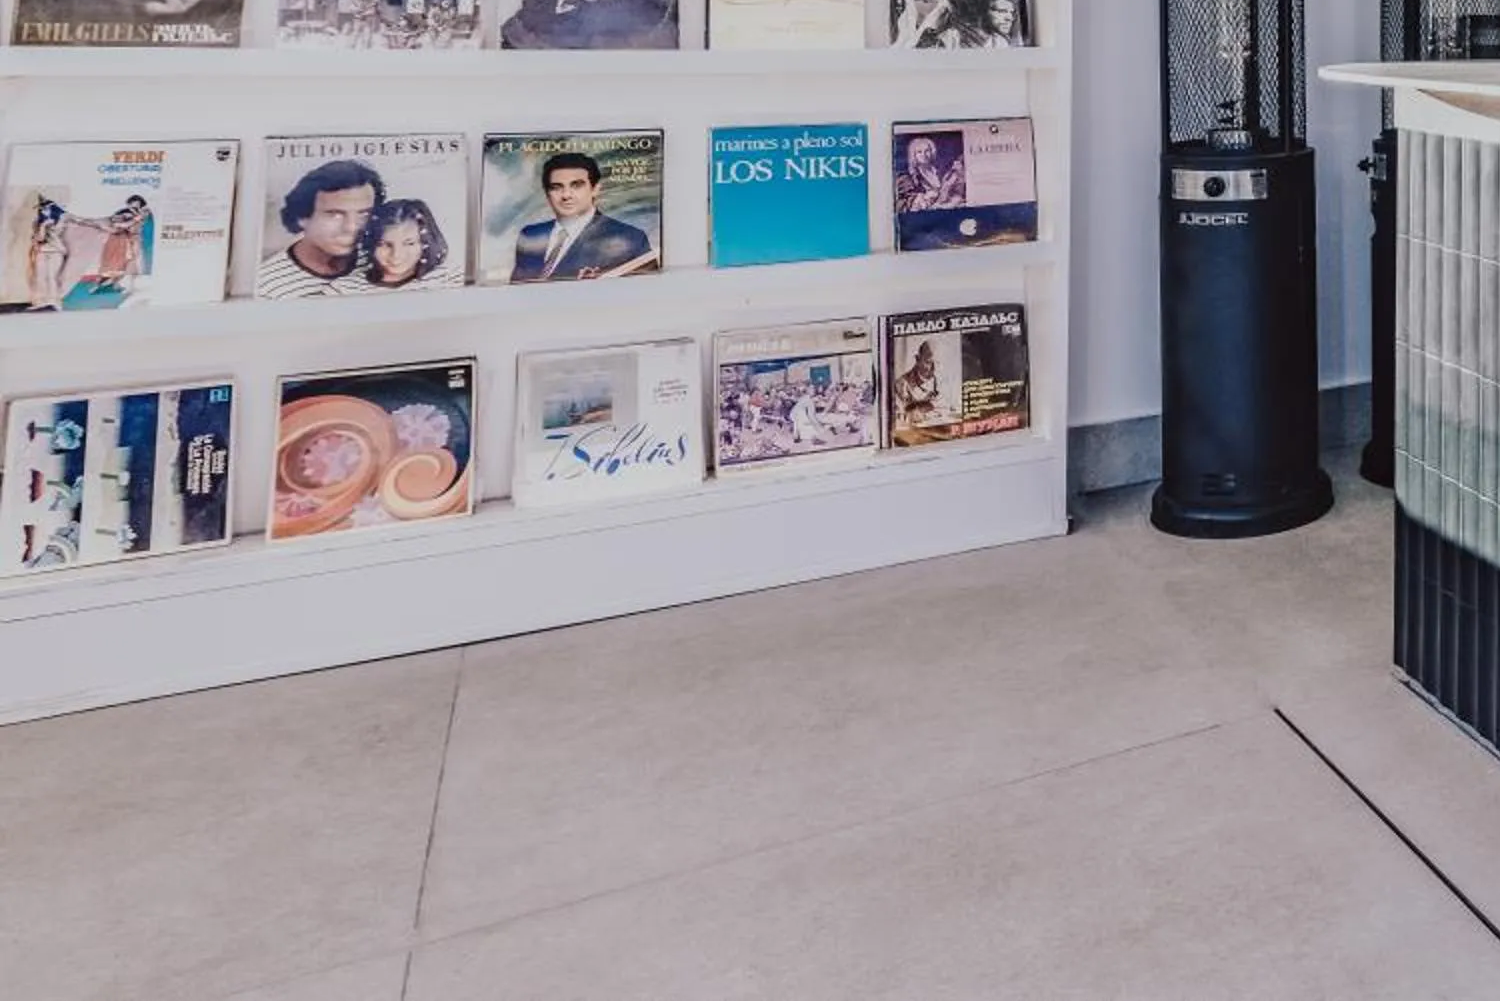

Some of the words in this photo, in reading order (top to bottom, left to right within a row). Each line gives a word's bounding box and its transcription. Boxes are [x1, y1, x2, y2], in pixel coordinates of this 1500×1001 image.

[277, 144, 342, 158] JULIO
[353, 139, 460, 156] IGLESIAS
[715, 135, 779, 152] marines
[782, 137, 791, 149] a
[793, 130, 837, 156] pleno
[840, 129, 863, 147] sol
[715, 159, 773, 184] LOS
[784, 155, 865, 181] NIKIS
